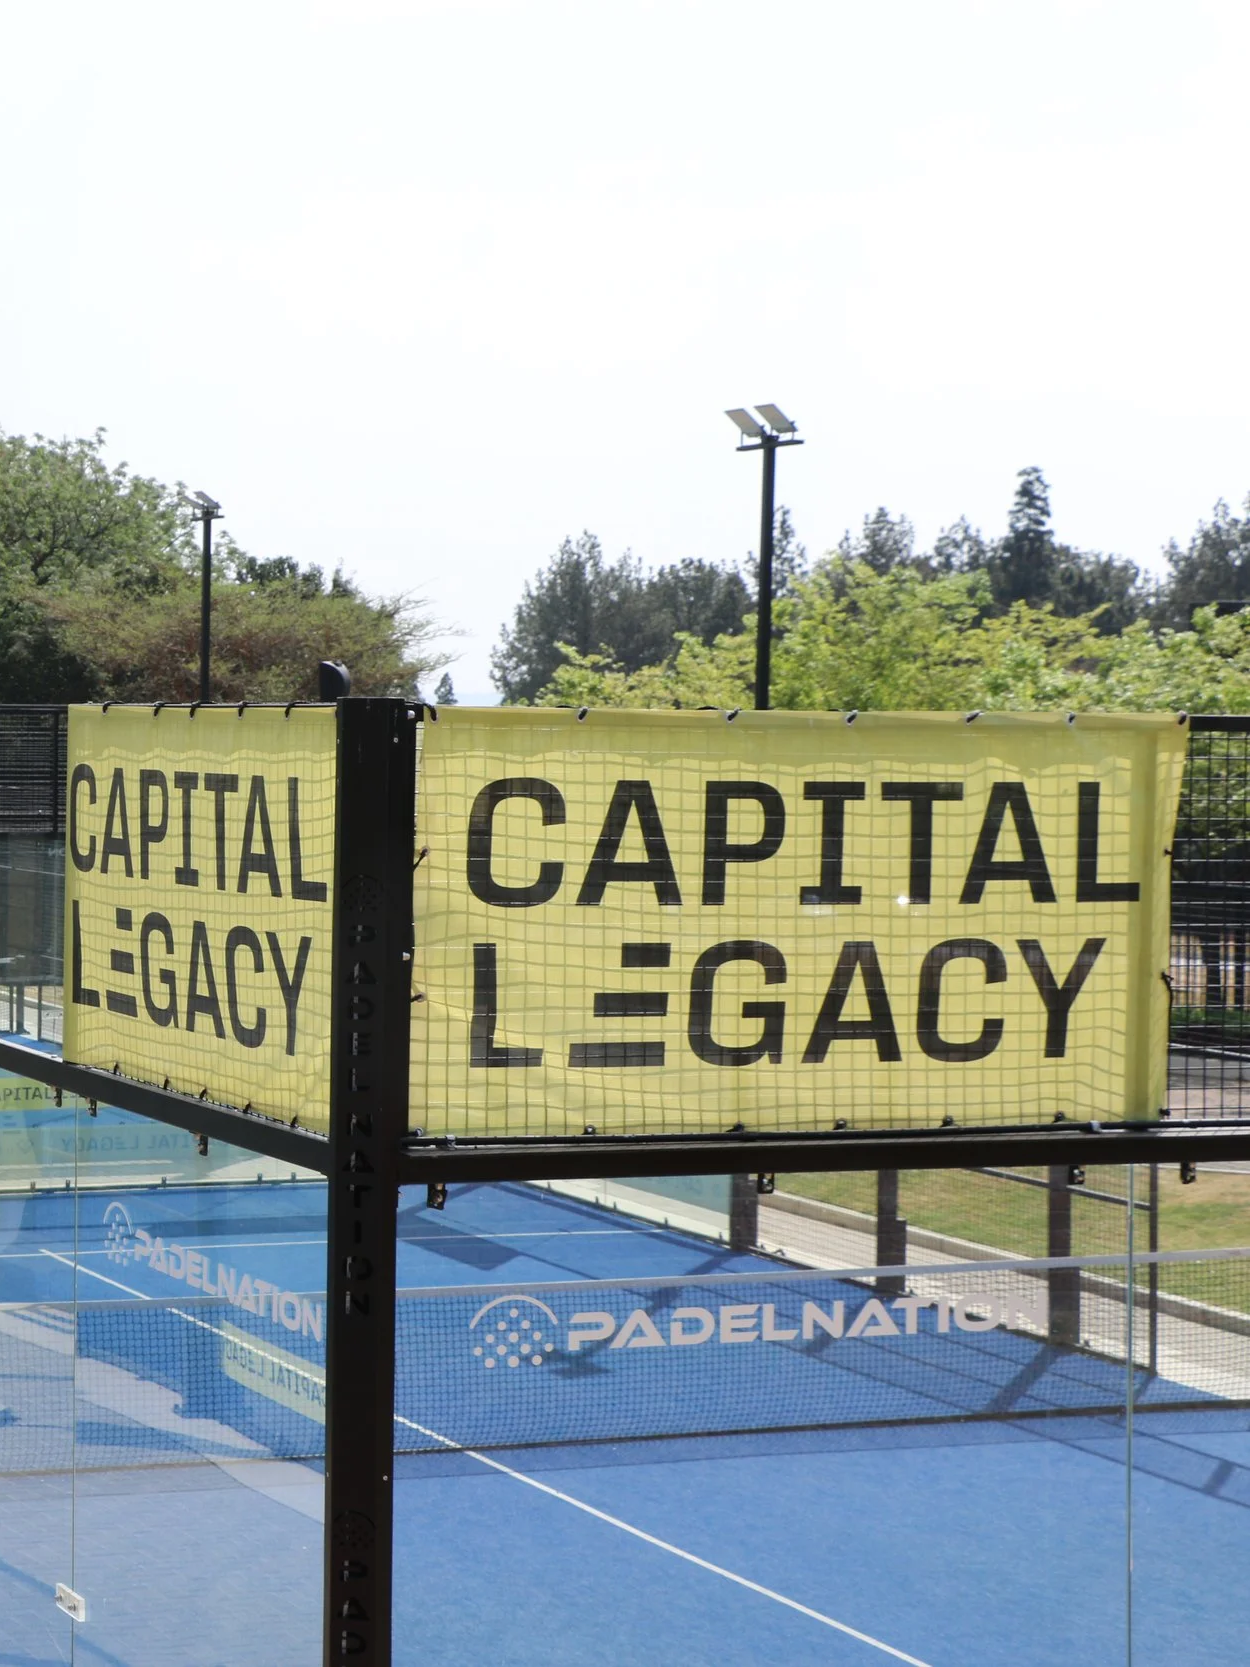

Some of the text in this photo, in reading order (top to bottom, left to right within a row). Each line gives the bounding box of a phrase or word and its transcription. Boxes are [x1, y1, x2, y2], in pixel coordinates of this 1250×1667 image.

[70, 763, 327, 903] CAPITAL
[464, 776, 1141, 909] CAPITAL
[71, 899, 312, 1057] LEGACY
[469, 937, 1107, 1068] LEGACY
[134, 1228, 323, 1343] PADELNATION
[567, 1289, 1049, 1352] PADELNATION
